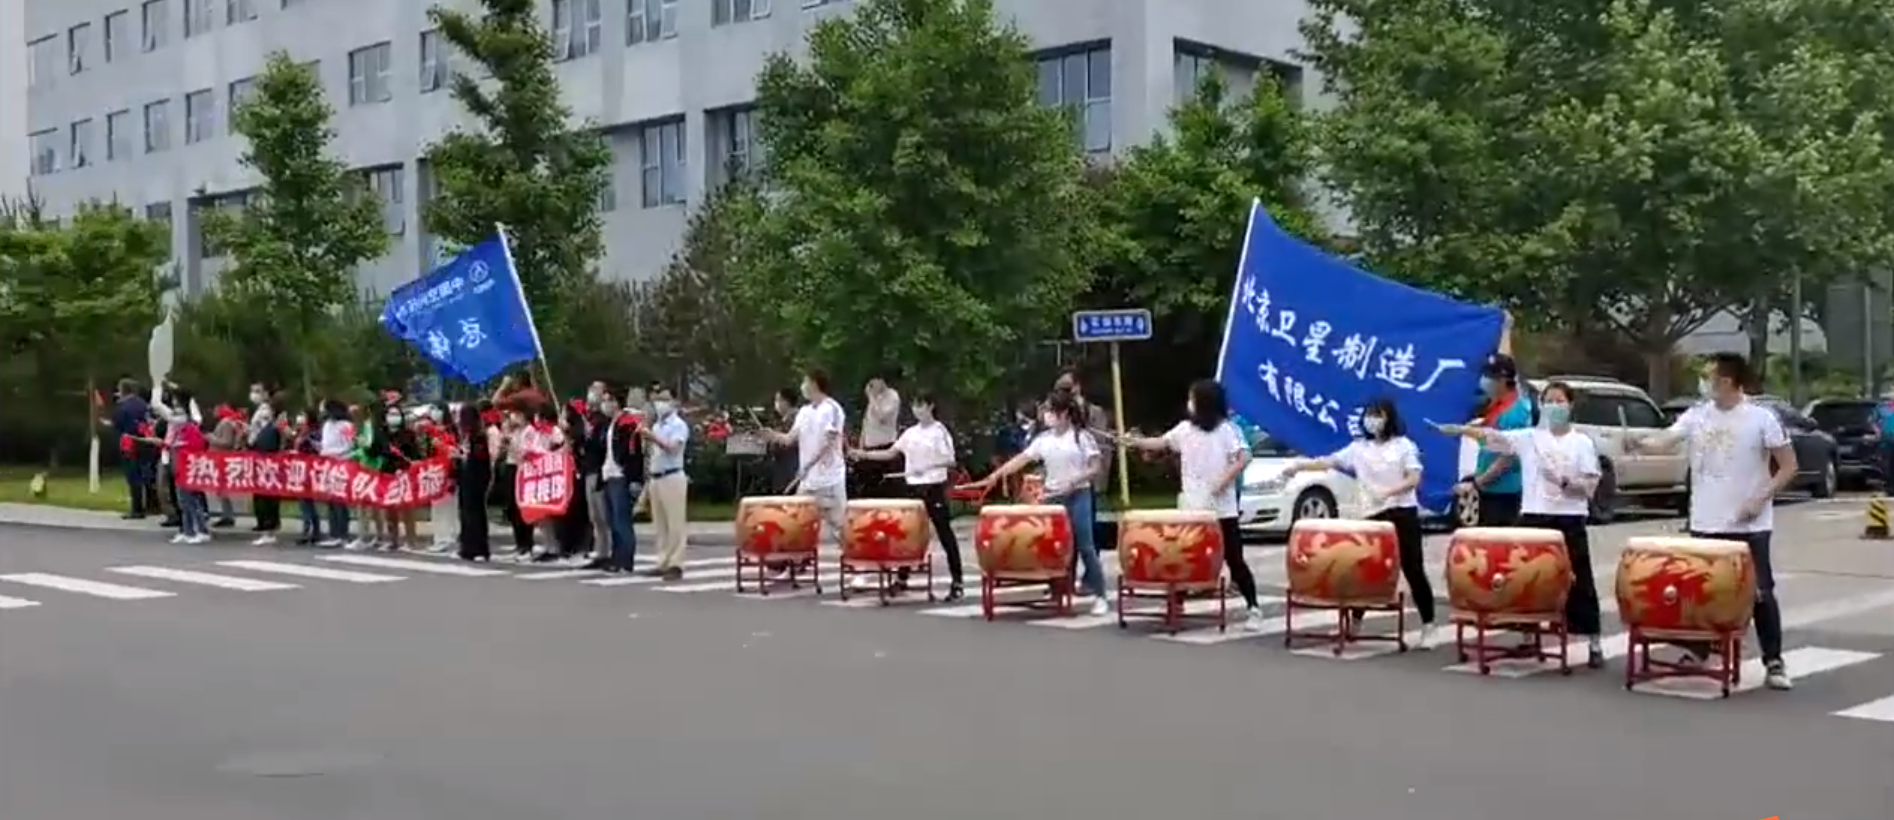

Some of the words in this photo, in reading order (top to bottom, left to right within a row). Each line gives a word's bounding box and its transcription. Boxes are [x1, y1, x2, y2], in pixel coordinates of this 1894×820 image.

[1242, 273, 1466, 392] 北京卫星制造厂
[186, 454, 446, 504] 热烈欢迎试验队凯旋
